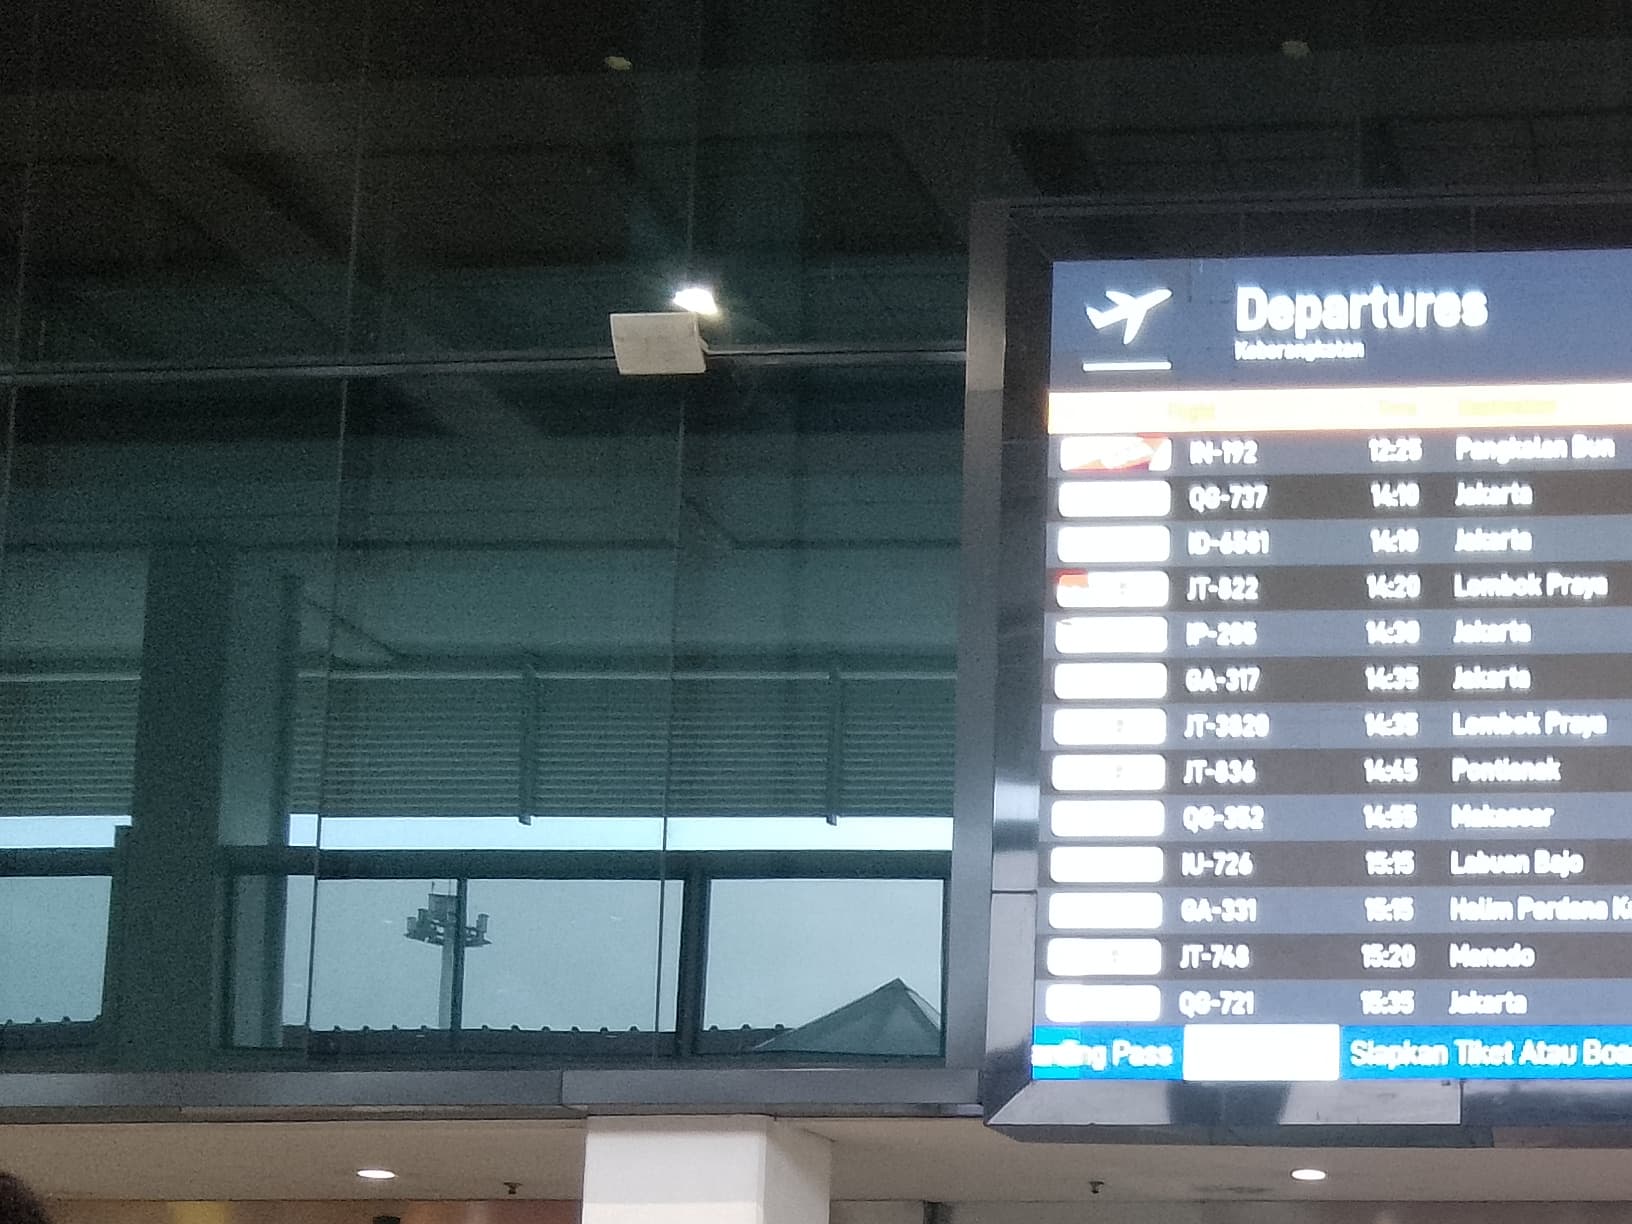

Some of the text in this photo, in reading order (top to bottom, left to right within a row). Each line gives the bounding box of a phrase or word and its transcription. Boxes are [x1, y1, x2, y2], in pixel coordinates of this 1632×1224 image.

[1235, 284, 1489, 340] Departures
[1455, 435, 1568, 465] Pangkalan
[1454, 481, 1533, 506] Jakarta
[1454, 527, 1533, 552] Jakarta
[1454, 573, 1543, 598] Lombok
[1546, 572, 1609, 600] Praya
[1453, 619, 1532, 644] Jakarta
[1452, 665, 1531, 690] Jakarta
[1452, 711, 1541, 736] Lombok
[1544, 710, 1608, 739] Praya
[1452, 757, 1562, 782] Pontianak
[1451, 804, 1555, 829] Makassar
[1181, 851, 1253, 876] IU-726
[1450, 850, 1530, 875] Labuan
[1534, 849, 1584, 878] Bajo
[1450, 896, 1514, 921] Halim
[1517, 896, 1609, 921] Perdana
[1449, 942, 1535, 968] Manado
[1448, 990, 1528, 1015] Jakarta
[1113, 1040, 1173, 1066] Pass
[1351, 1040, 1448, 1069] Siapkan
[1456, 1039, 1514, 1065] Tiket
[1519, 1039, 1577, 1065] Atau
